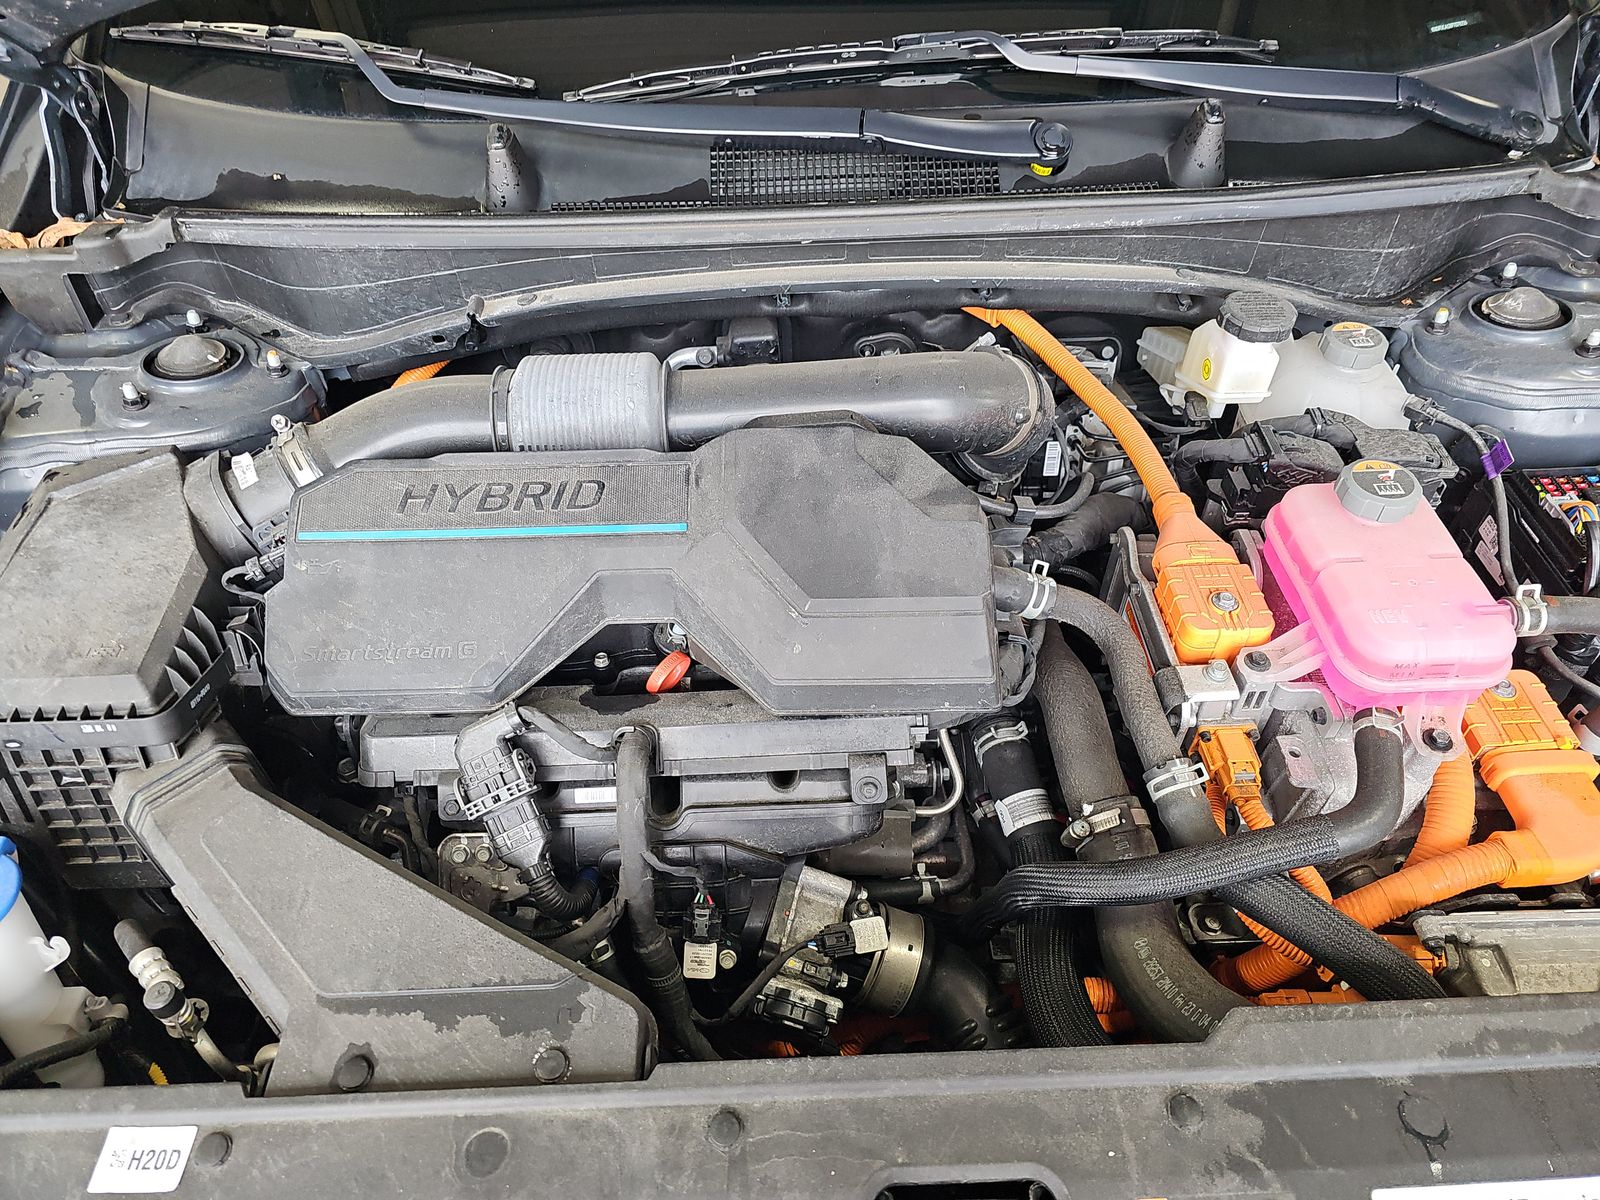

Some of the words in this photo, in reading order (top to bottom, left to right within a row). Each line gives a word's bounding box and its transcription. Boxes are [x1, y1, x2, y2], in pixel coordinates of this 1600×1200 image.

[396, 479, 606, 515] HYBRID
[302, 644, 453, 663] Smartstream
[457, 640, 478, 660] G
[1181, 1001, 1196, 1017] 23
